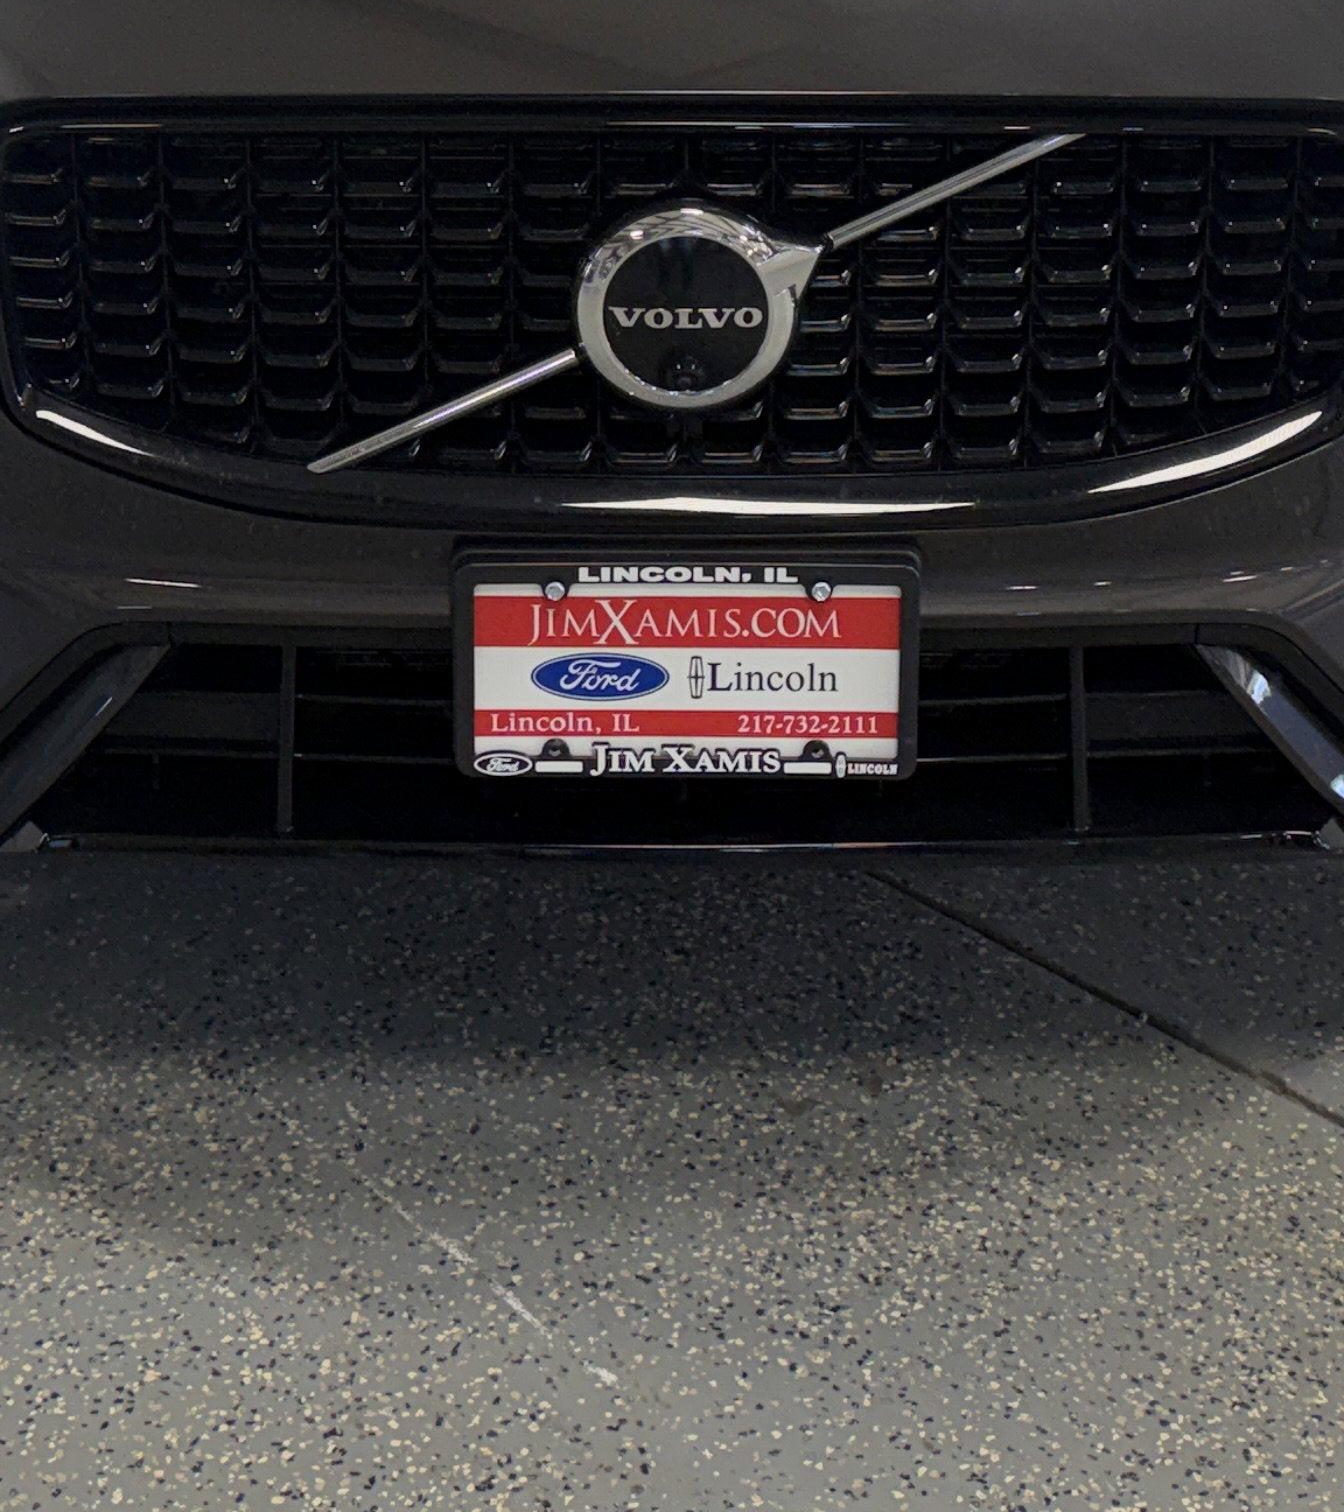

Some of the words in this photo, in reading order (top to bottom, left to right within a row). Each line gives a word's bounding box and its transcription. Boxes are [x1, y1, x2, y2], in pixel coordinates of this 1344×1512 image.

[608, 306, 763, 329] VOLVO
[578, 566, 752, 583] LINCOLN,
[763, 567, 798, 583] IL
[559, 658, 641, 692] Ford
[707, 662, 838, 692] Lincoln
[490, 712, 602, 734] Lincoln,
[613, 713, 640, 733] IL
[738, 714, 878, 735] 217-732-2111
[589, 742, 656, 777] JIM
[662, 744, 781, 774] XAMIS
[847, 762, 898, 775] LINCOLN
